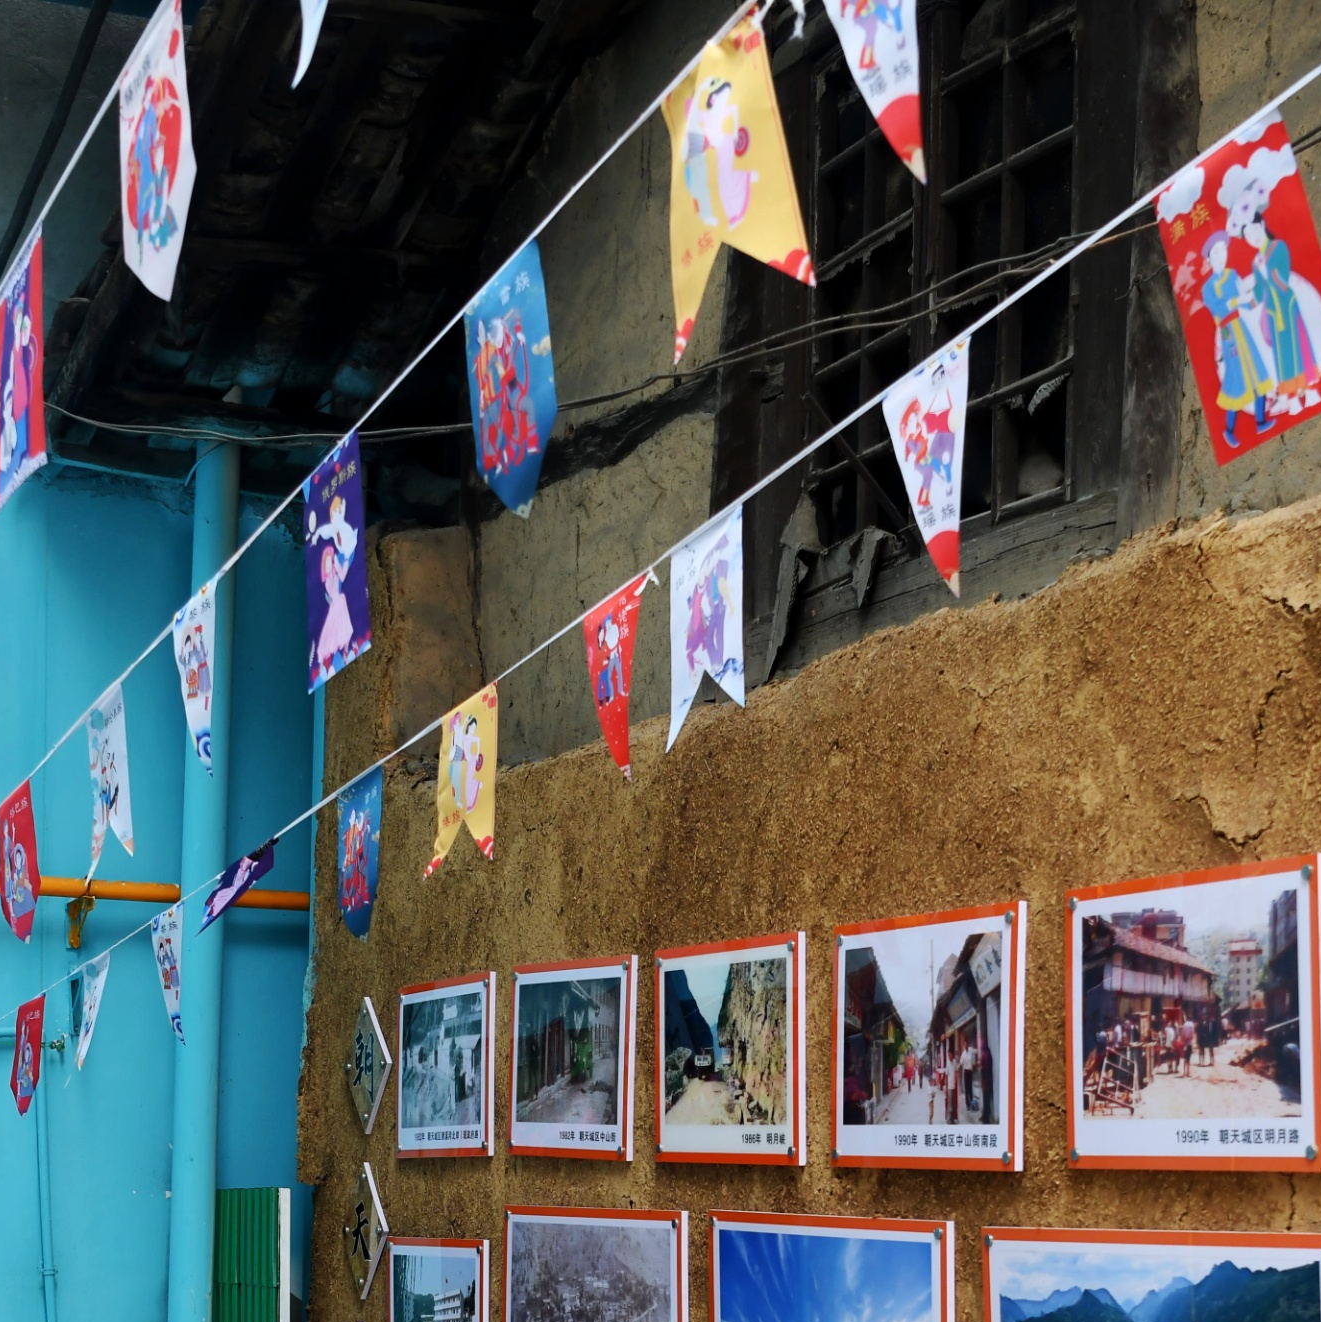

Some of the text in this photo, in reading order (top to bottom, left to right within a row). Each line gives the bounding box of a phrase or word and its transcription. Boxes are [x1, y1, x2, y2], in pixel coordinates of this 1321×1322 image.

[1169, 203, 1210, 245] 满族
[322, 460, 357, 503] 俄罗斯族
[922, 503, 956, 529] 瑶族
[352, 1027, 375, 1105] 朝
[579, 1130, 616, 1142] 朝天城区中山街
[894, 1133, 997, 1148] 1990年 朝天城区中山街南段
[1176, 1128, 1299, 1145] 1990年 朝天城区明月路
[351, 1200, 372, 1261] 天
